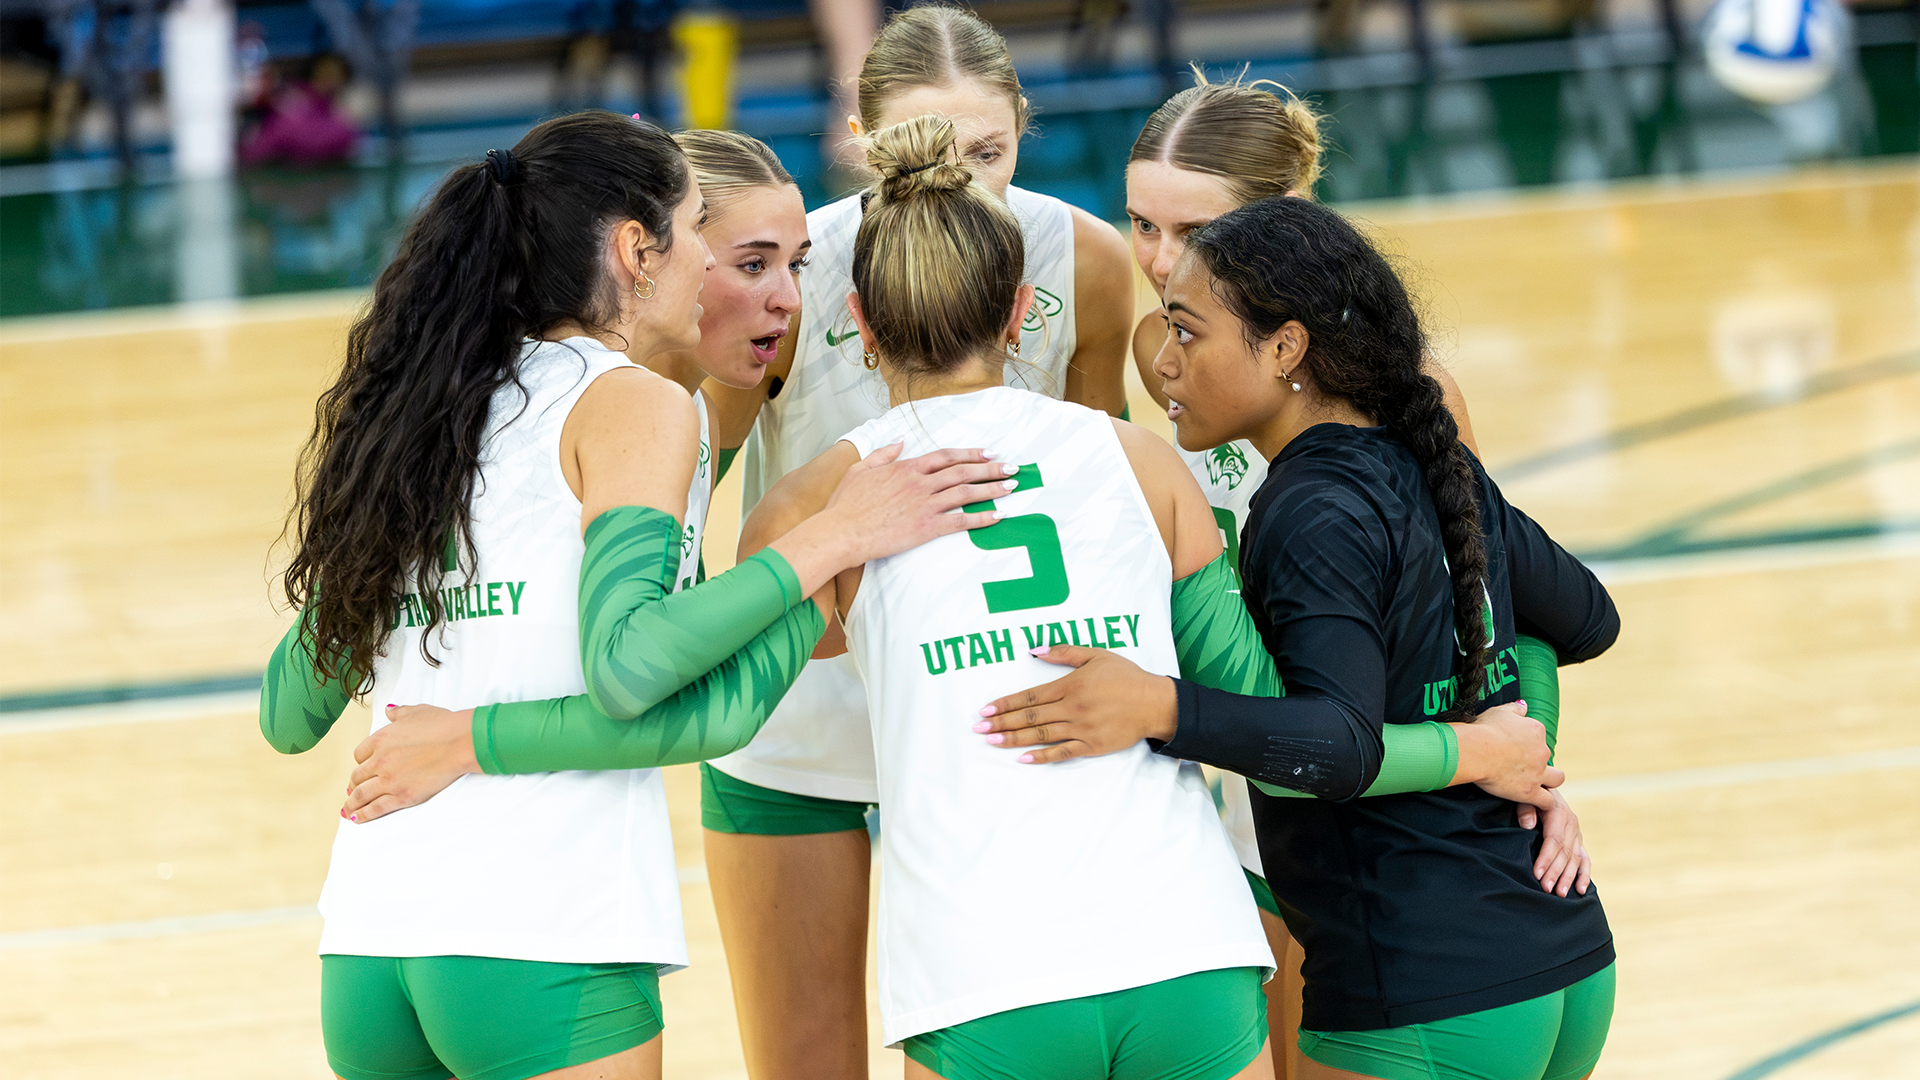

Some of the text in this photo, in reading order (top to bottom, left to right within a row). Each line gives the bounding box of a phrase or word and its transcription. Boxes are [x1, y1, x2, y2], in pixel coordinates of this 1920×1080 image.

[961, 462, 1070, 614] 5
[440, 581, 527, 622] VALLEY
[919, 614, 1140, 676] UTAH VALLEY
